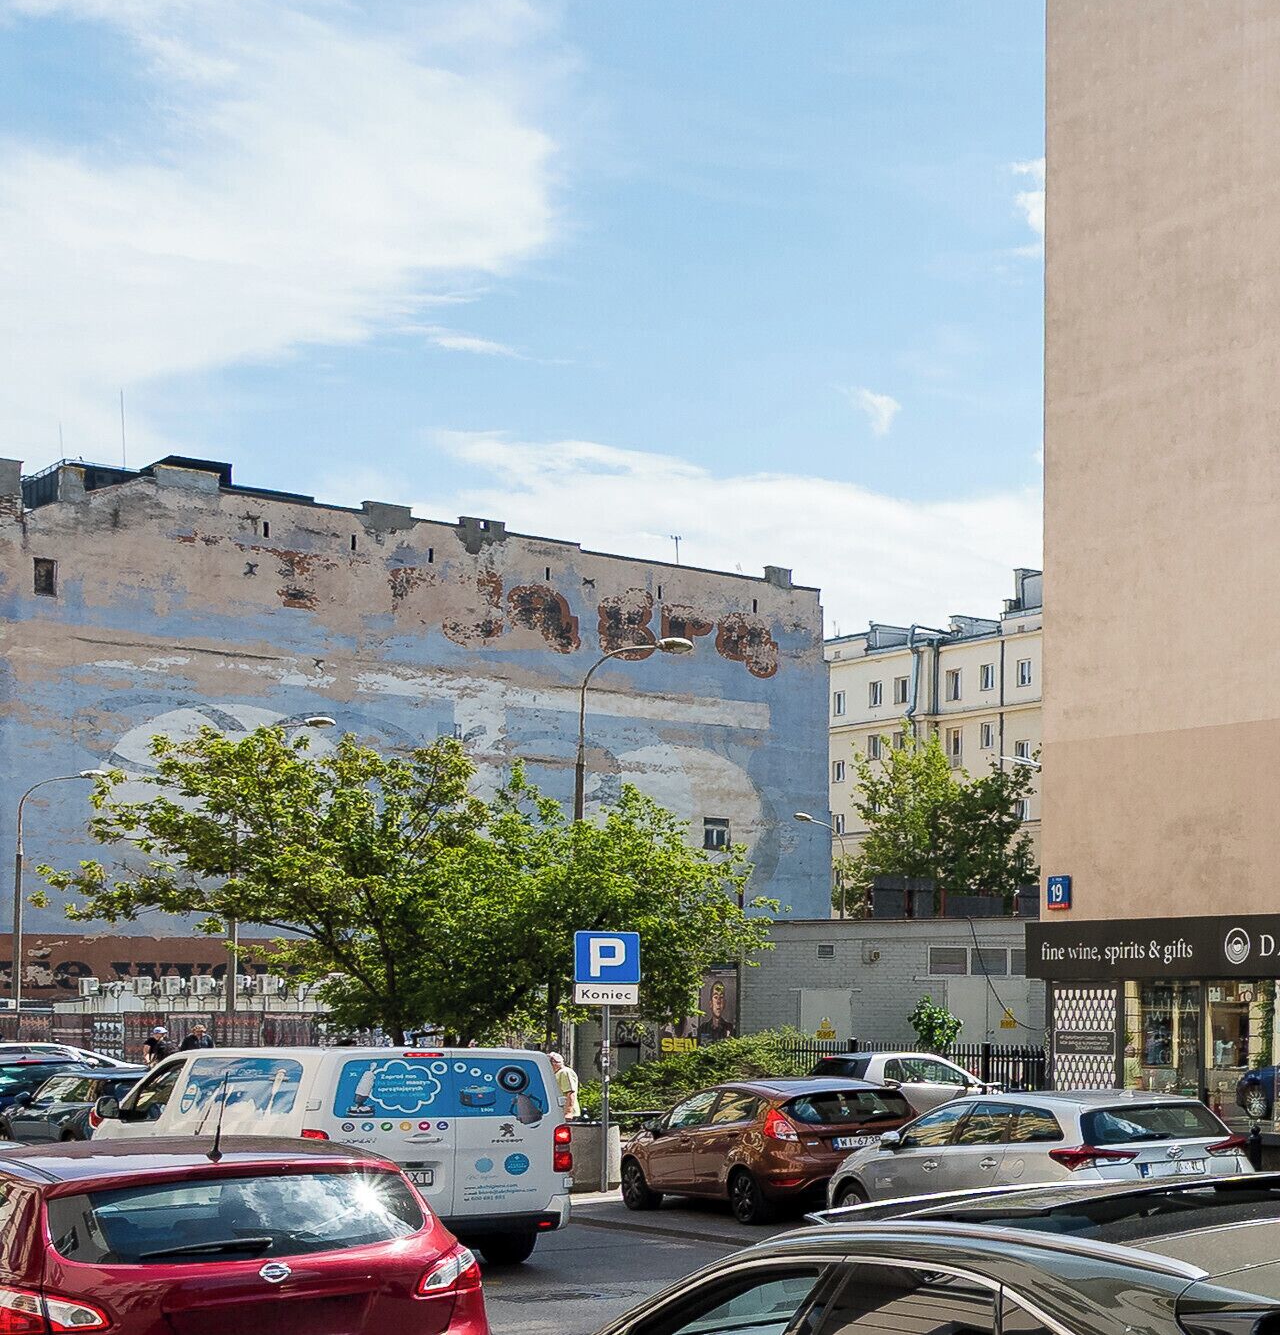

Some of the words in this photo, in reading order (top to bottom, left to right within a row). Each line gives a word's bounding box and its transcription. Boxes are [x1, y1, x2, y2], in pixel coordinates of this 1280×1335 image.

[1050, 883, 1063, 902] 19
[589, 937, 626, 977] P
[1041, 941, 1065, 960] fine
[1068, 942, 1101, 961] wine,
[1104, 941, 1146, 965] spirits
[1148, 940, 1161, 958] &
[1163, 938, 1193, 964] gifts
[581, 989, 632, 1000] Koniec
[858, 1134, 881, 1146] 673P
